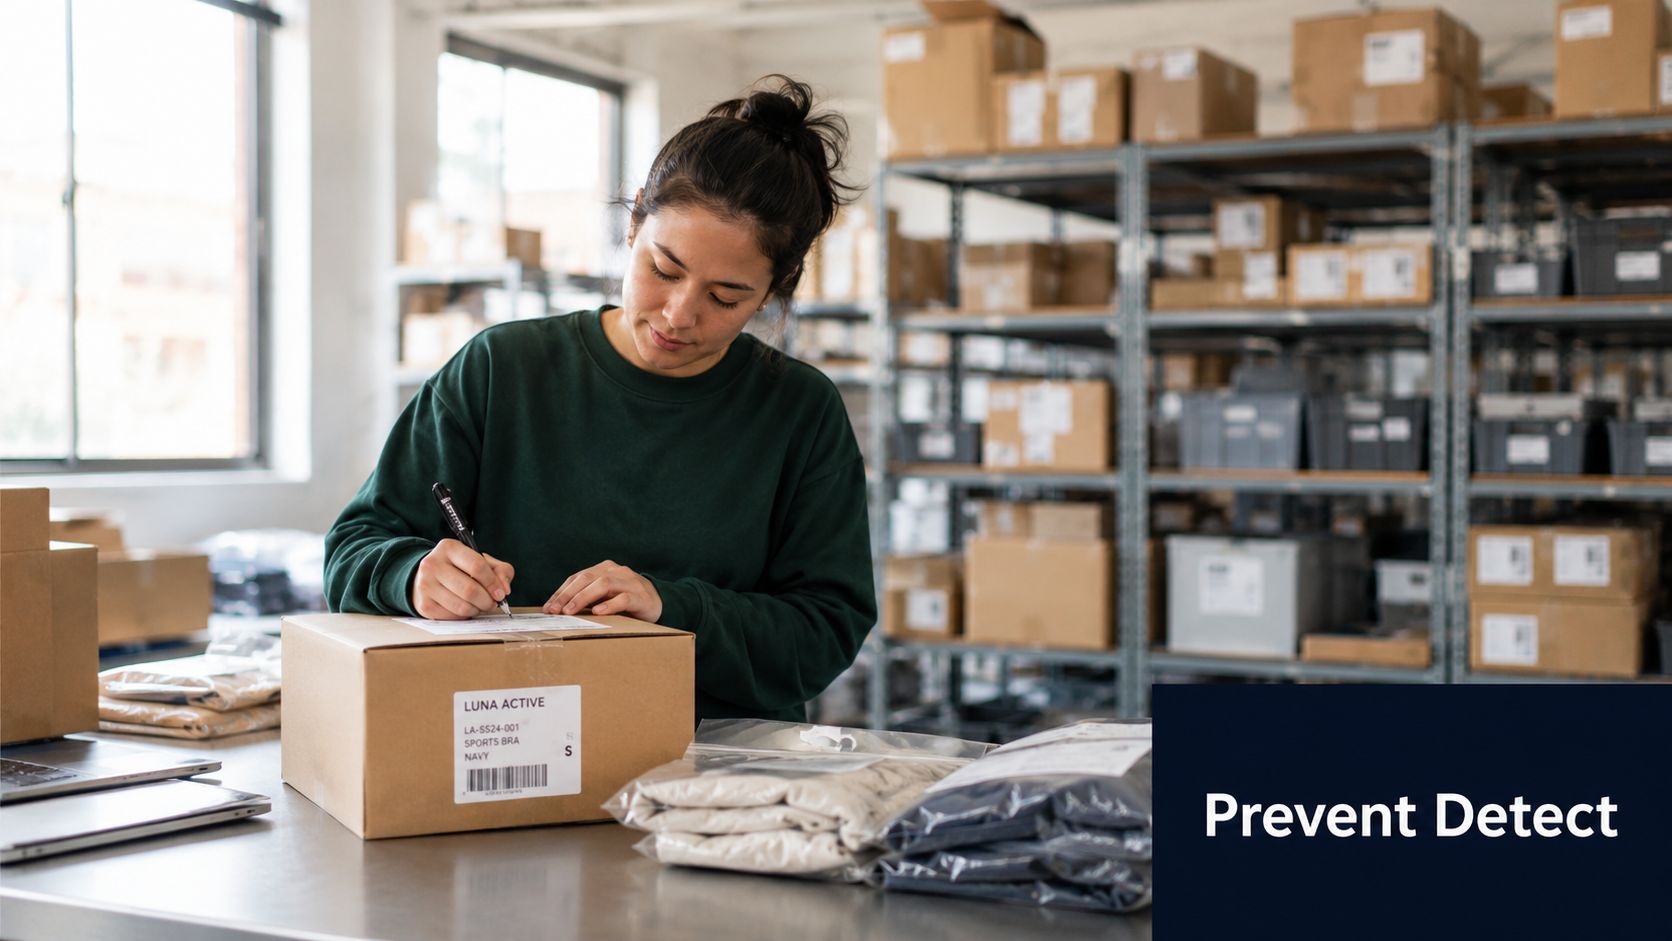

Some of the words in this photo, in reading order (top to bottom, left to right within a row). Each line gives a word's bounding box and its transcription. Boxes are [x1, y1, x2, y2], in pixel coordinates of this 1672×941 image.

[464, 700, 498, 712] LUNA
[501, 697, 545, 709] ACTIVE
[464, 738, 499, 748] SPORTS
[501, 736, 520, 746] BRA
[464, 752, 489, 761] NAVY
[564, 745, 573, 757] S
